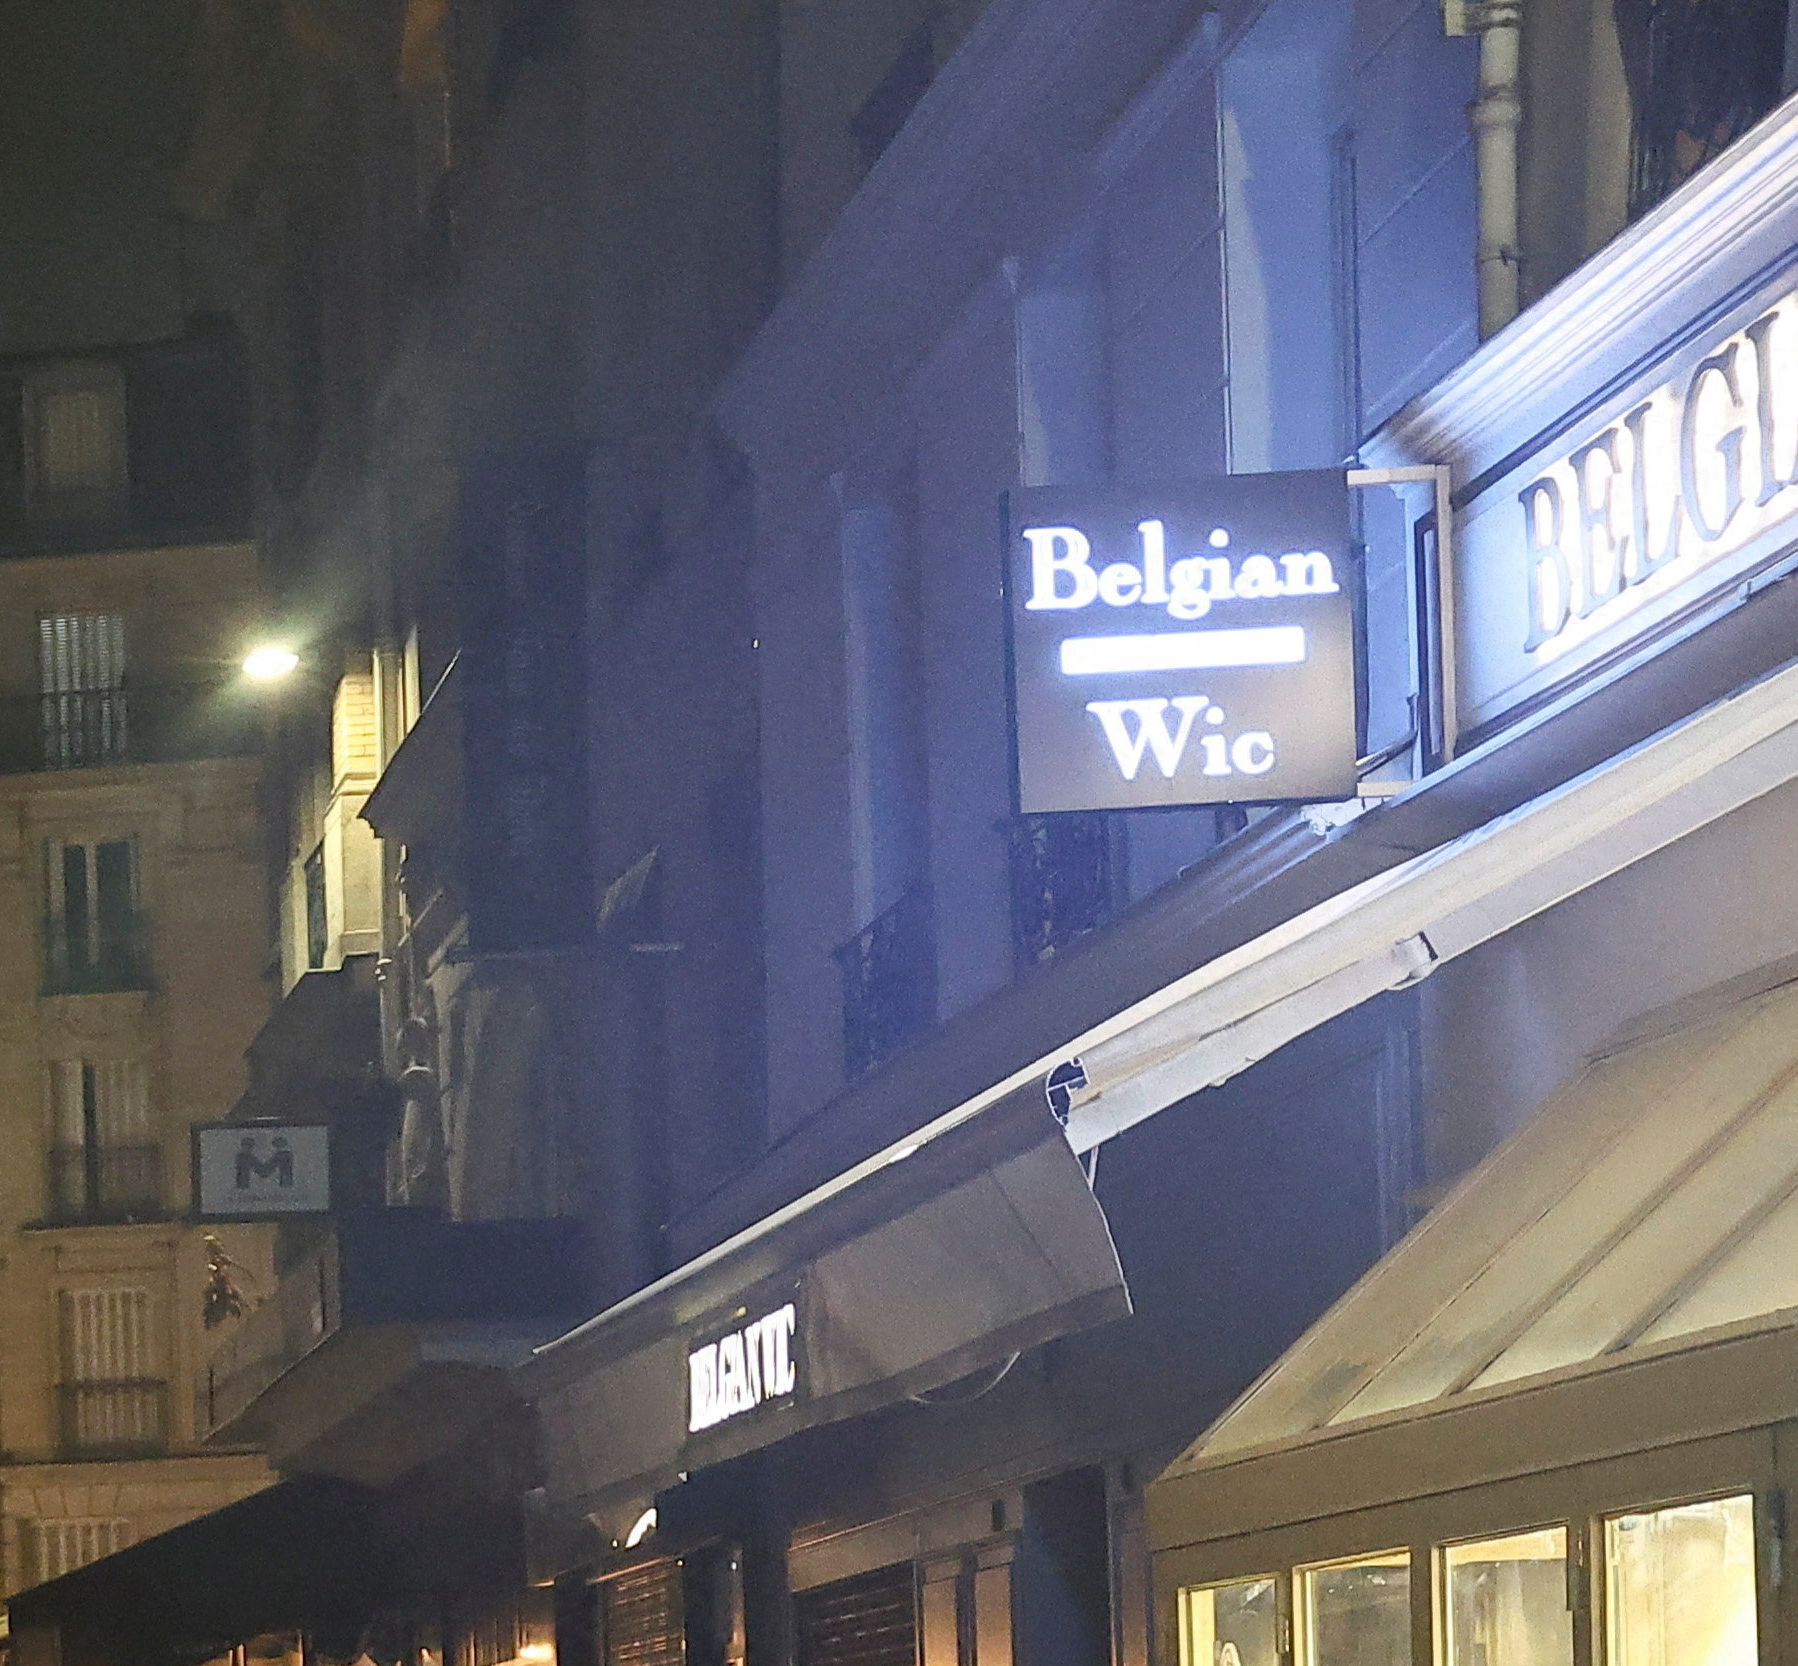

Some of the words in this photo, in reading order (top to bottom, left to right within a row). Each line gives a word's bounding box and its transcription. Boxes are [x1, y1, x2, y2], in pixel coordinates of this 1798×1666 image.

[1517, 308, 1798, 653] BELGI
[1022, 519, 1340, 620] Belgian
[1085, 696, 1275, 780] Wic
